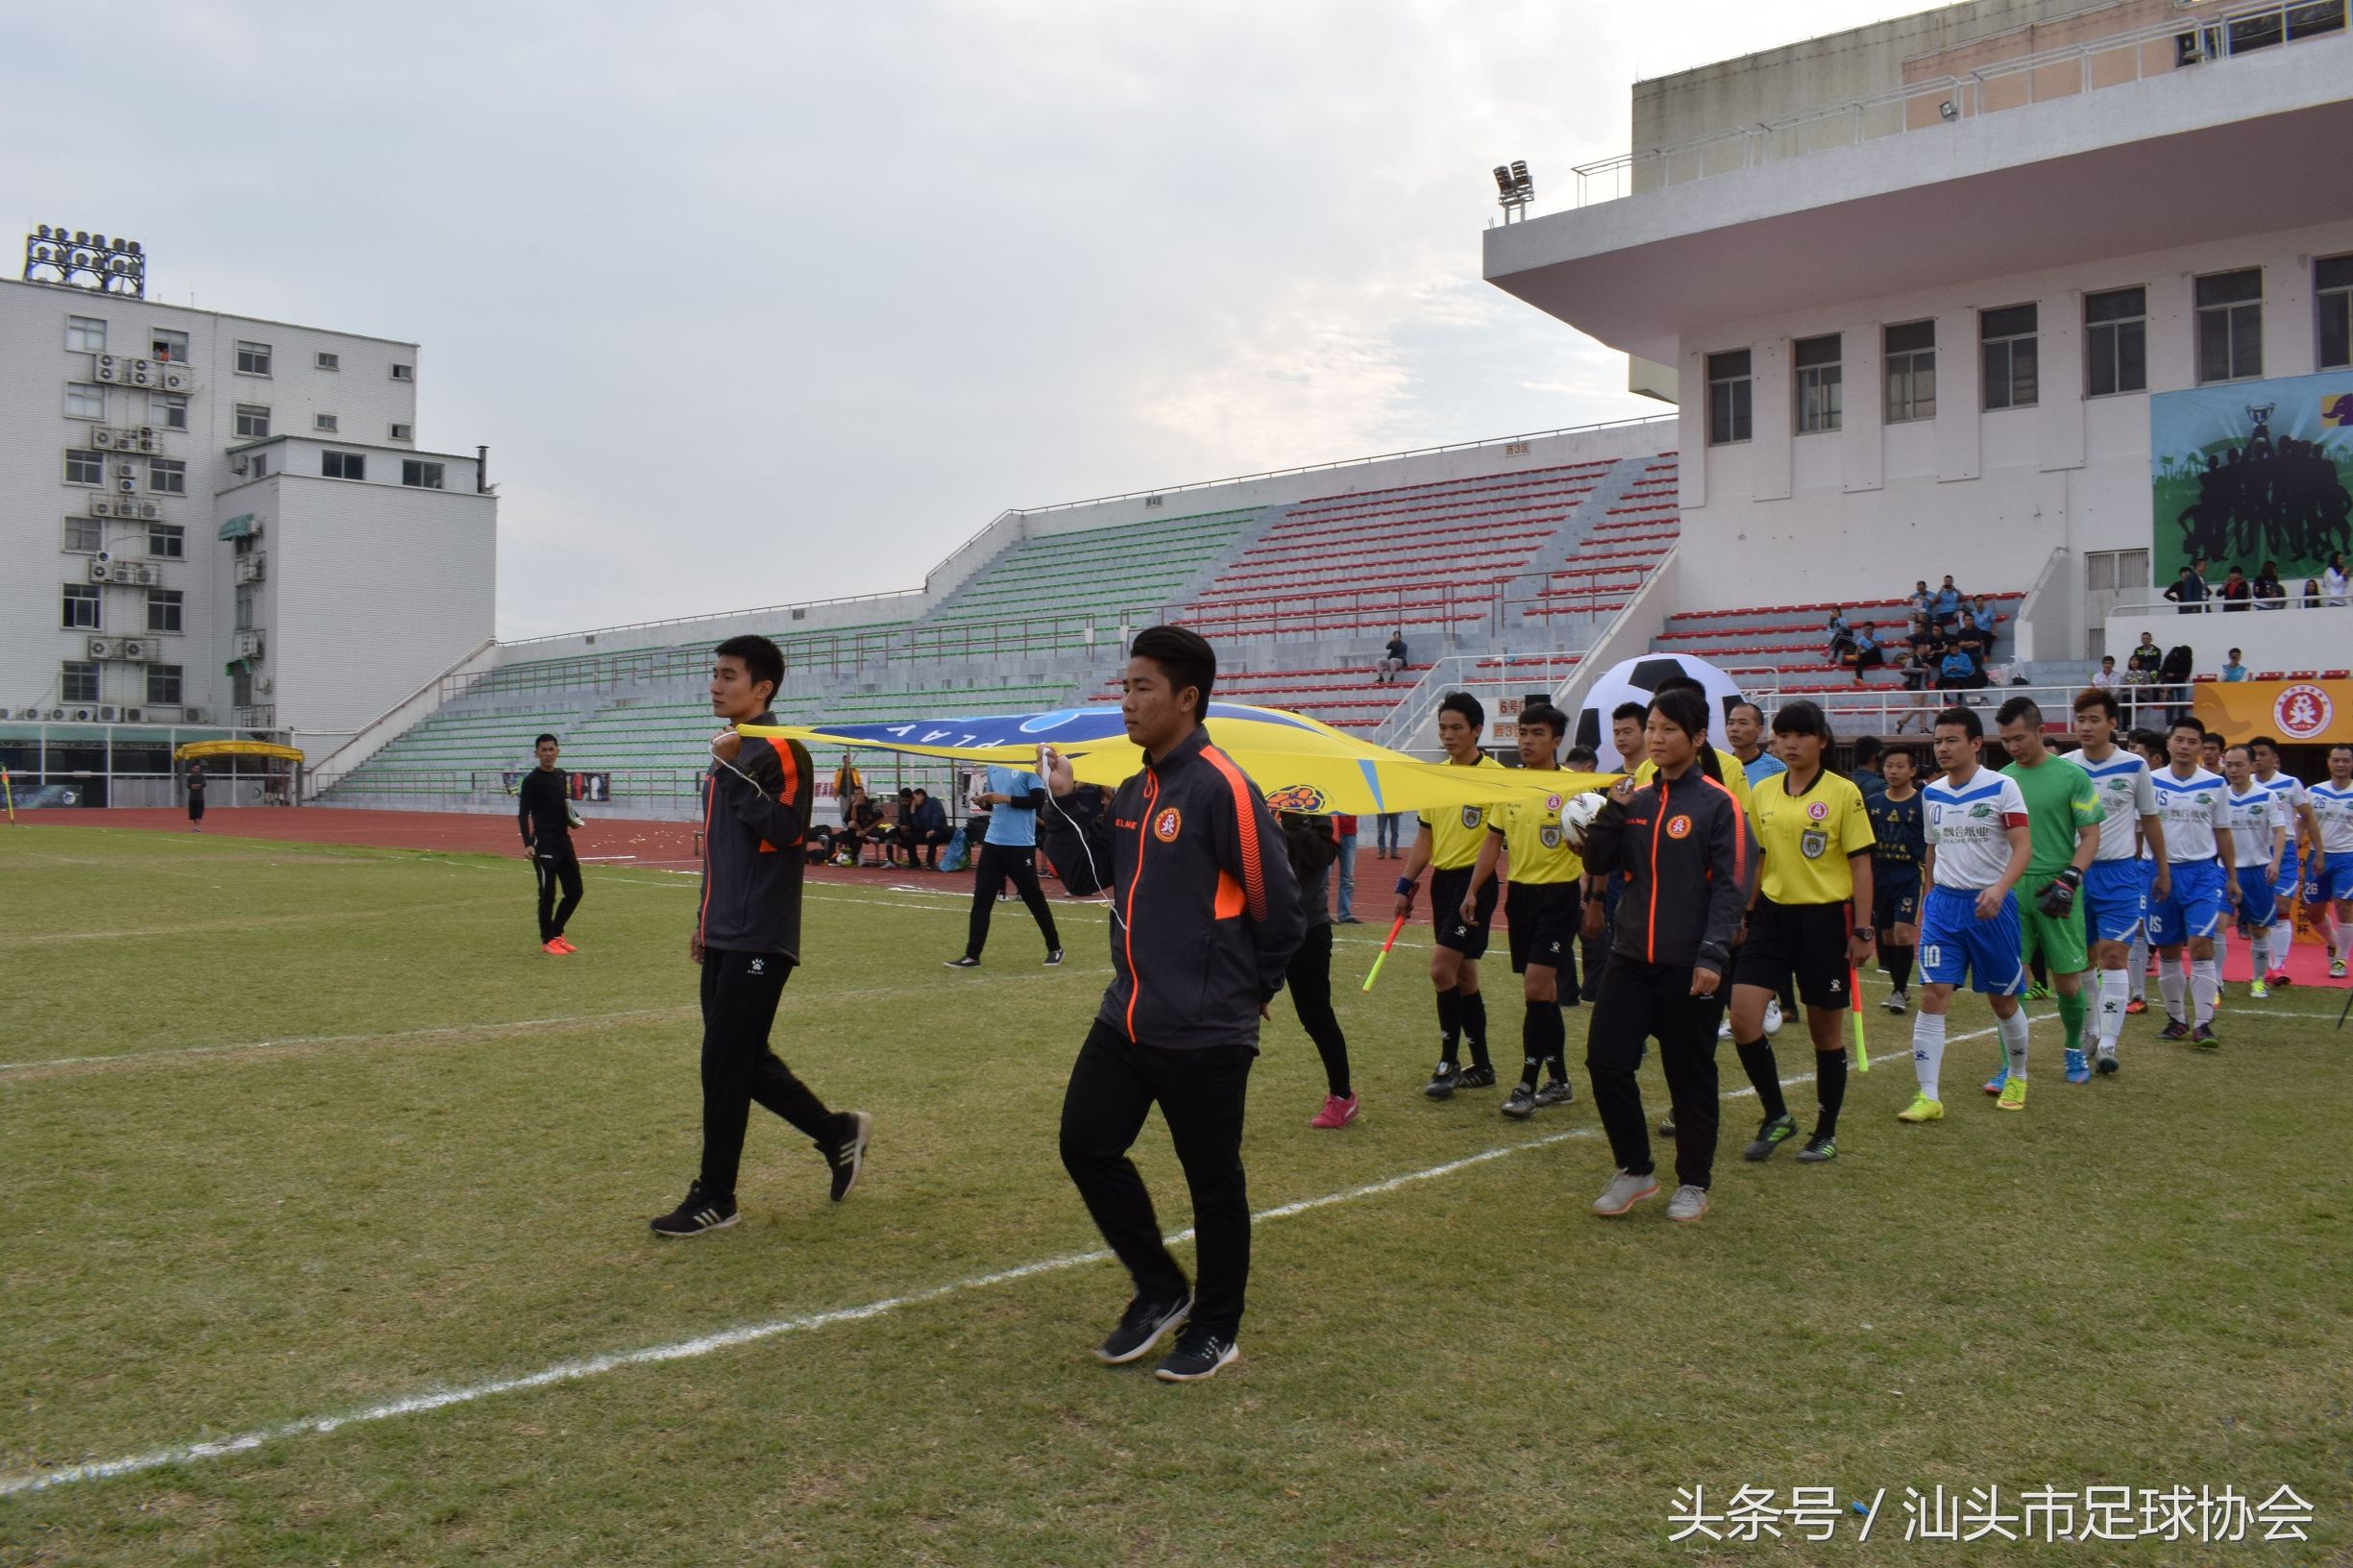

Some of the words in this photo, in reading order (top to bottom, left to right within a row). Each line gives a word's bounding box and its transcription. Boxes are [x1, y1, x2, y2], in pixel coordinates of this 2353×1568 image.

[1115, 818, 1138, 829] ELME
[2304, 882, 2318, 894] 26
[1924, 943, 1941, 968] 10
